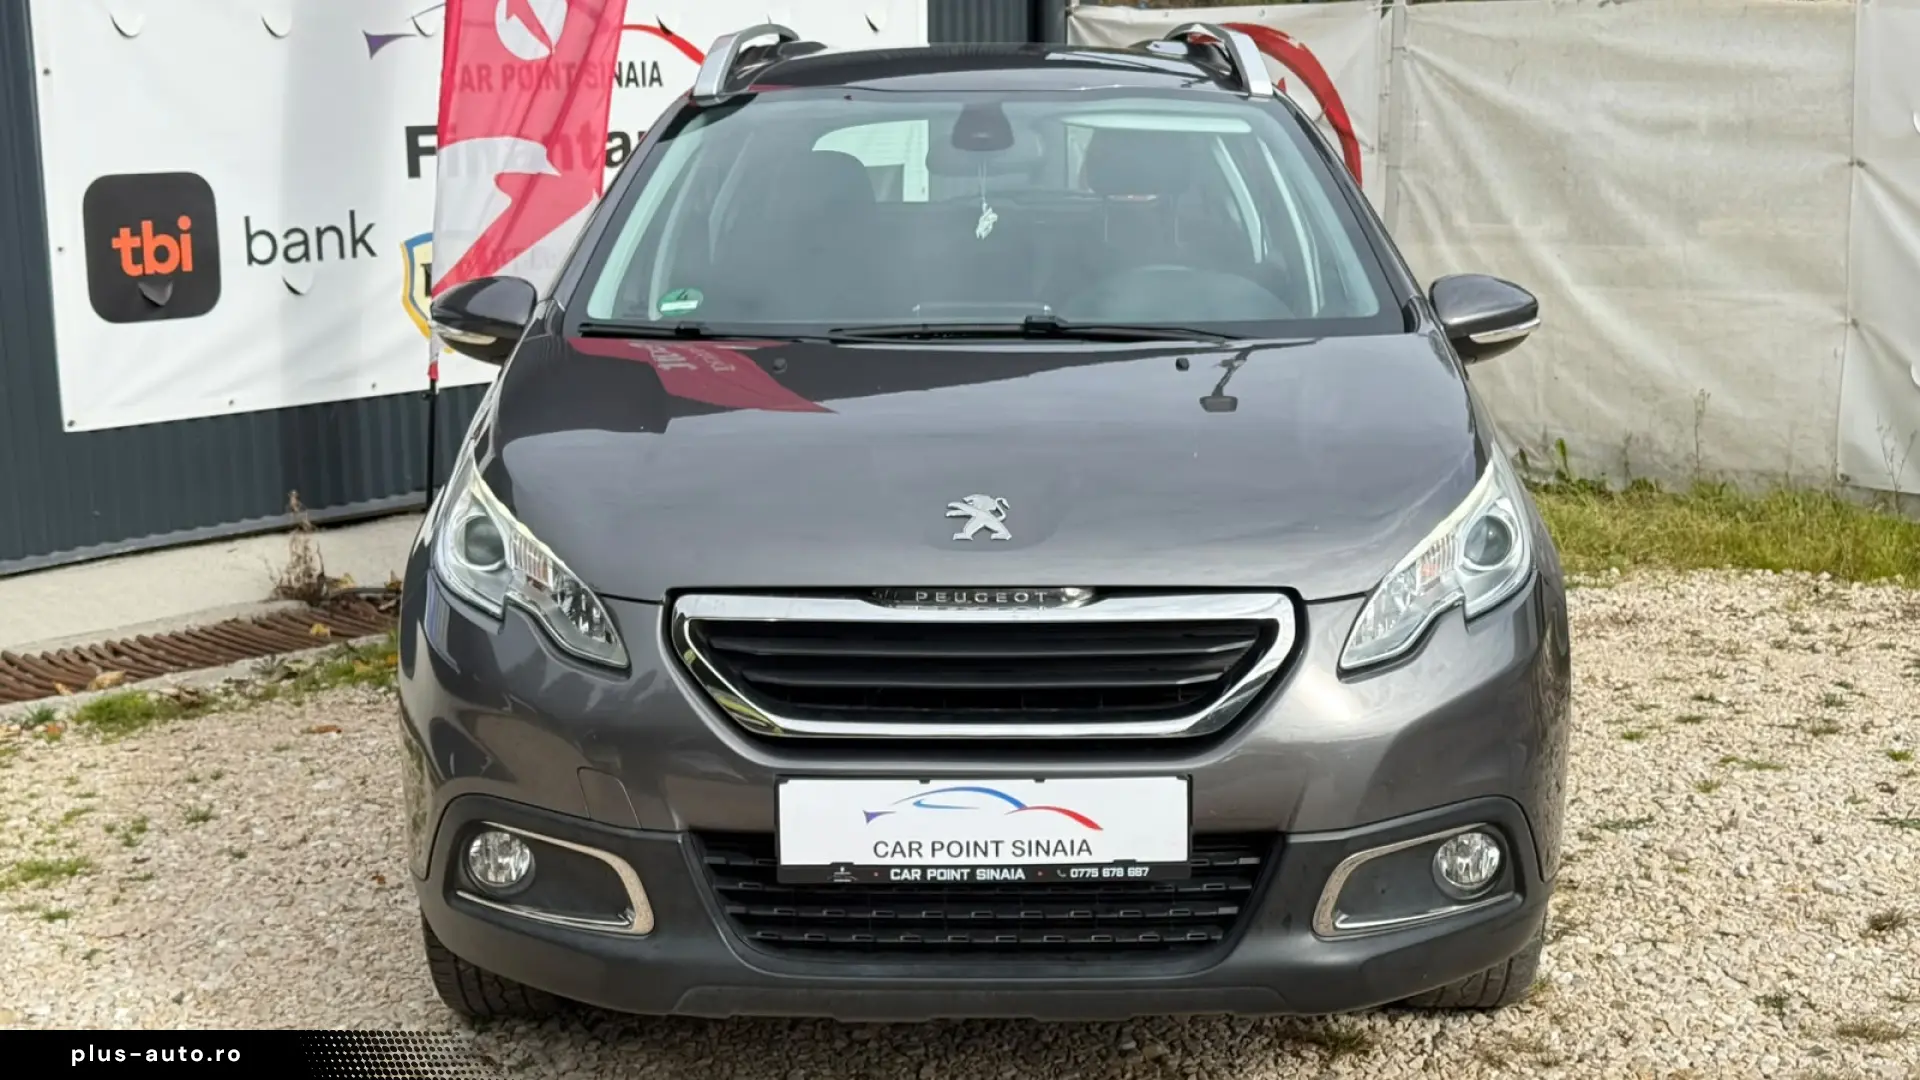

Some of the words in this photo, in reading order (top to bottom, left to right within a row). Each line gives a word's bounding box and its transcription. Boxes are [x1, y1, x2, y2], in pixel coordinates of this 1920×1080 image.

[112, 215, 194, 277] tbi
[243, 210, 378, 266] bank
[915, 591, 1048, 603] PEUGEOT
[873, 840, 924, 859] CAR
[930, 840, 1004, 858] POINT
[1011, 838, 1093, 857] SINAIA
[889, 867, 924, 881] CAR
[926, 867, 973, 881] POINT
[975, 867, 1026, 881] SINAIA
[1069, 867, 1099, 878] 0775
